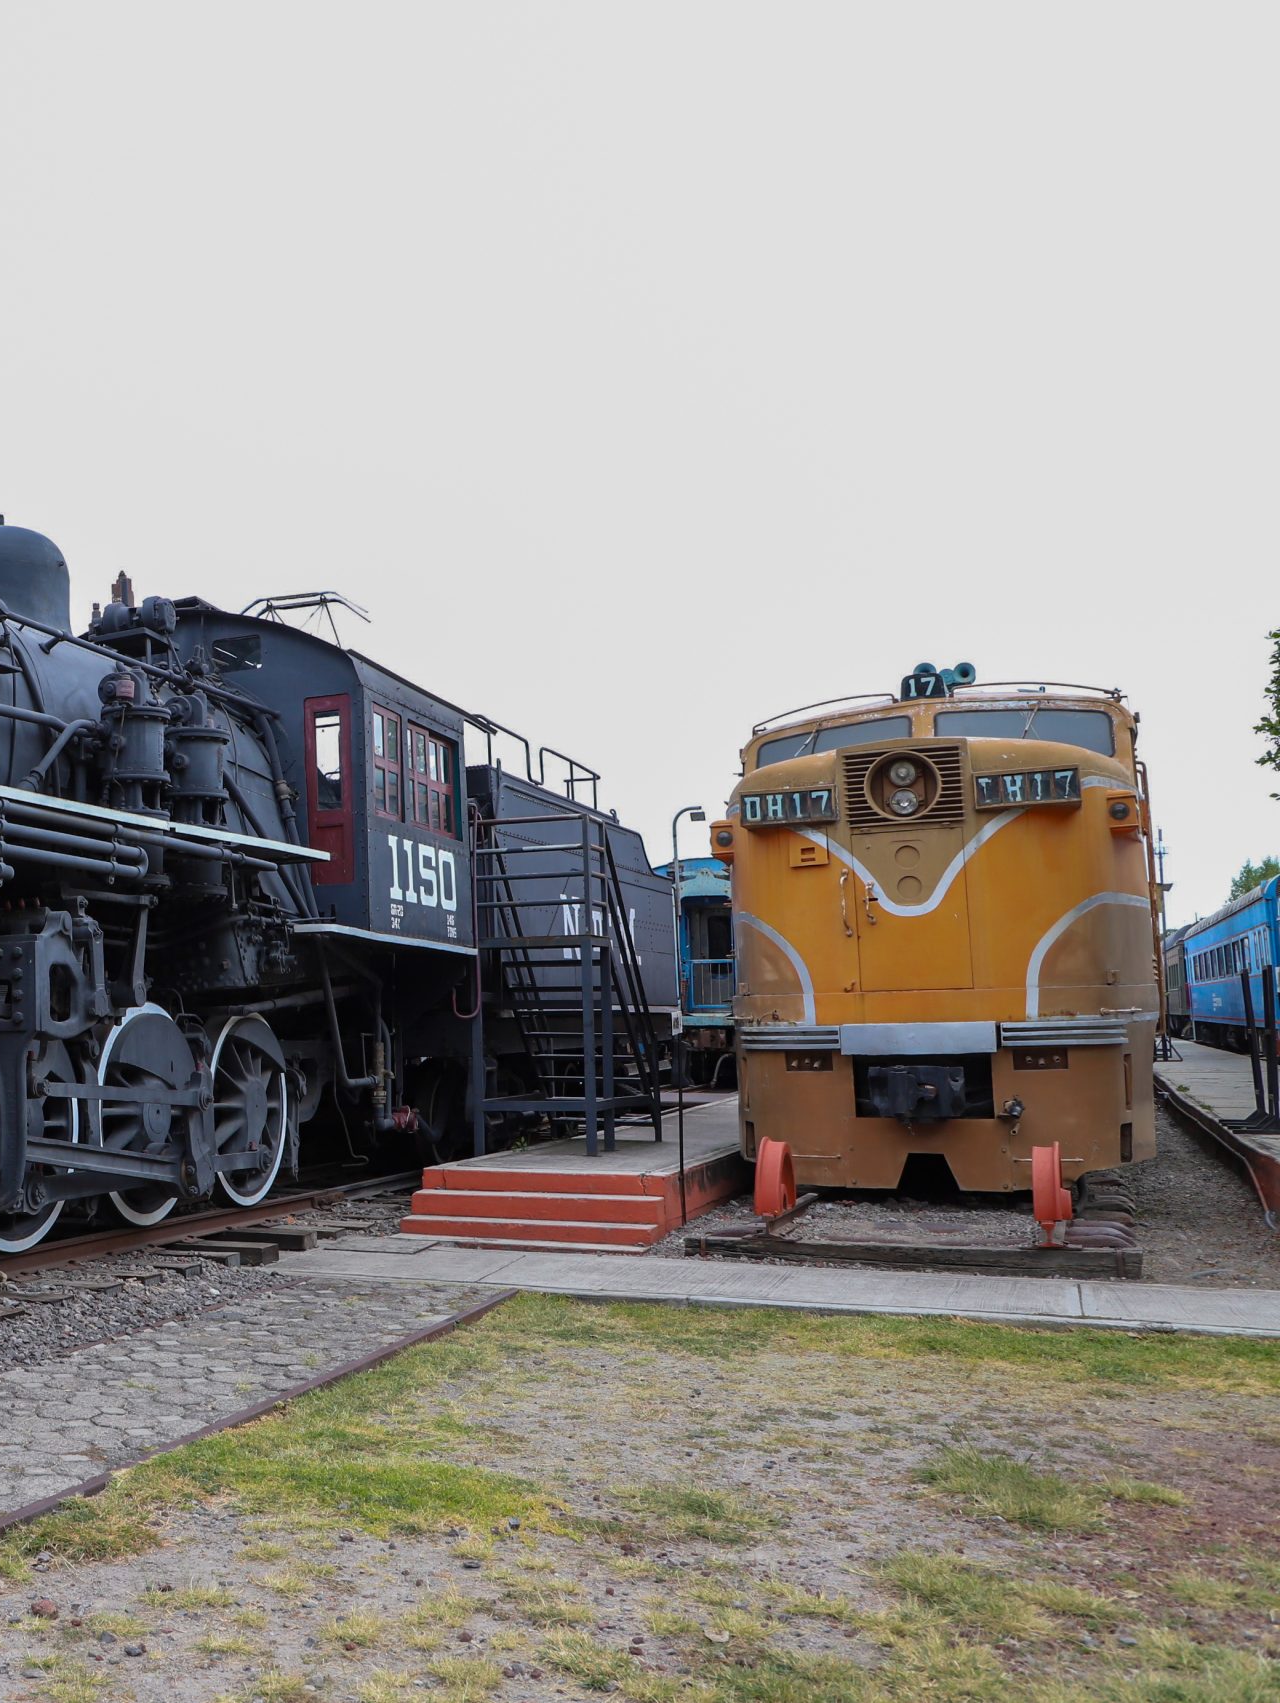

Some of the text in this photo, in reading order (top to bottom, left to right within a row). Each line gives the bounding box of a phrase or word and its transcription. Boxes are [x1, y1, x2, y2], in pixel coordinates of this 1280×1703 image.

[908, 676, 936, 697] 17
[743, 790, 829, 821] DH17
[387, 834, 457, 911] 1150
